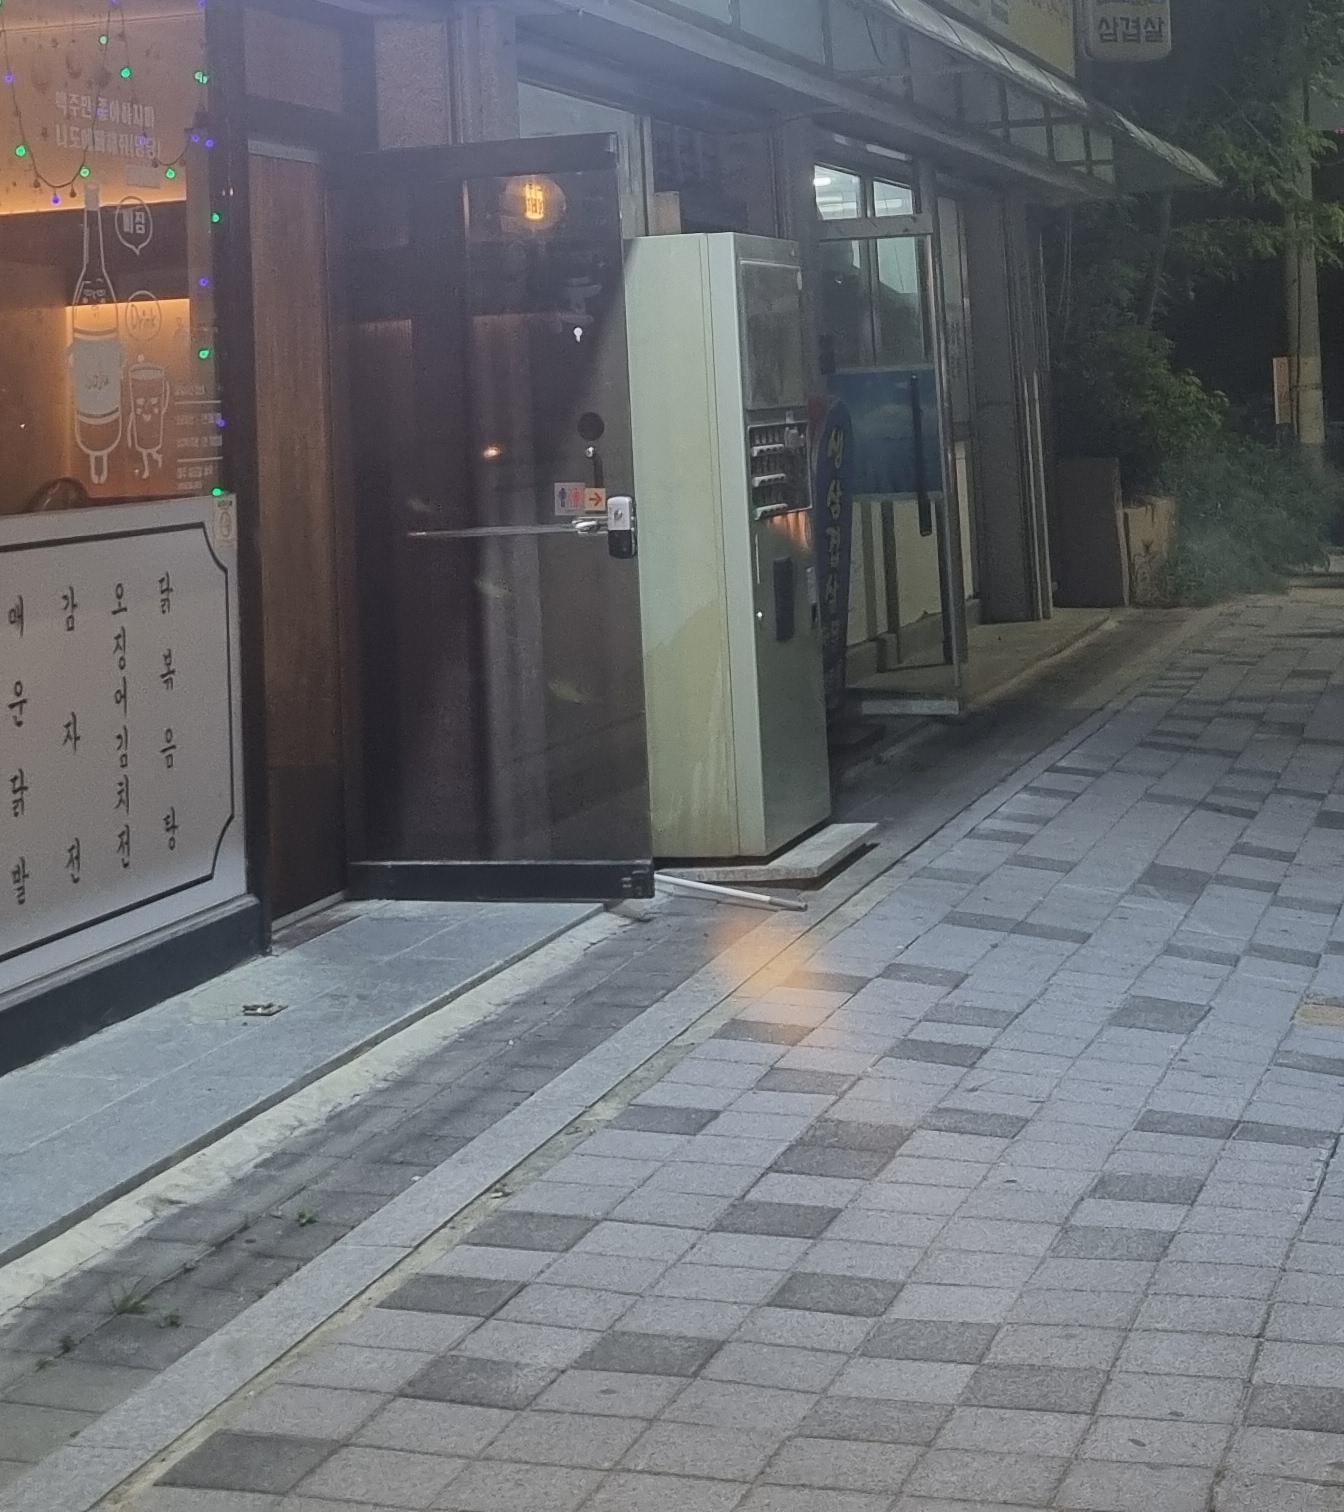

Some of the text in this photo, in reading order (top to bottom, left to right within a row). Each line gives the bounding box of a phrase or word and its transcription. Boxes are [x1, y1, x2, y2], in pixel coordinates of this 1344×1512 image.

[1097, 16, 1165, 44] 삼겹살
[60, 585, 81, 885] 감자전
[111, 582, 131, 869] 오징어김치전
